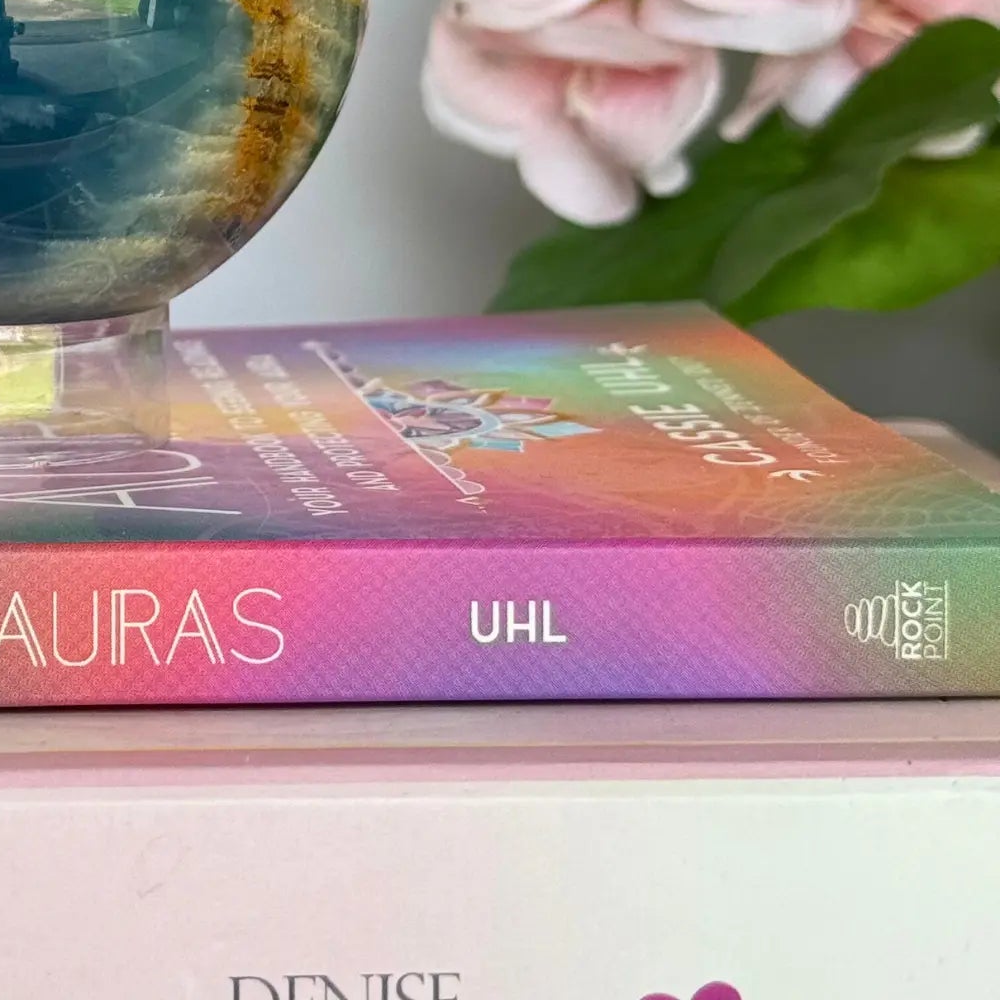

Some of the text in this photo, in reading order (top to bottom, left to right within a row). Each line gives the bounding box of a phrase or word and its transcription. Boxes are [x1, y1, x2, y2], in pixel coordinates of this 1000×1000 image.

[580, 356, 671, 396] UHL
[627, 403, 777, 466] CASSIE
[292, 486, 348, 516] YOUR
[346, 470, 399, 491] AND
[469, 600, 567, 644] UHL
[901, 581, 922, 660] ROCK
[923, 581, 943, 659] POINT
